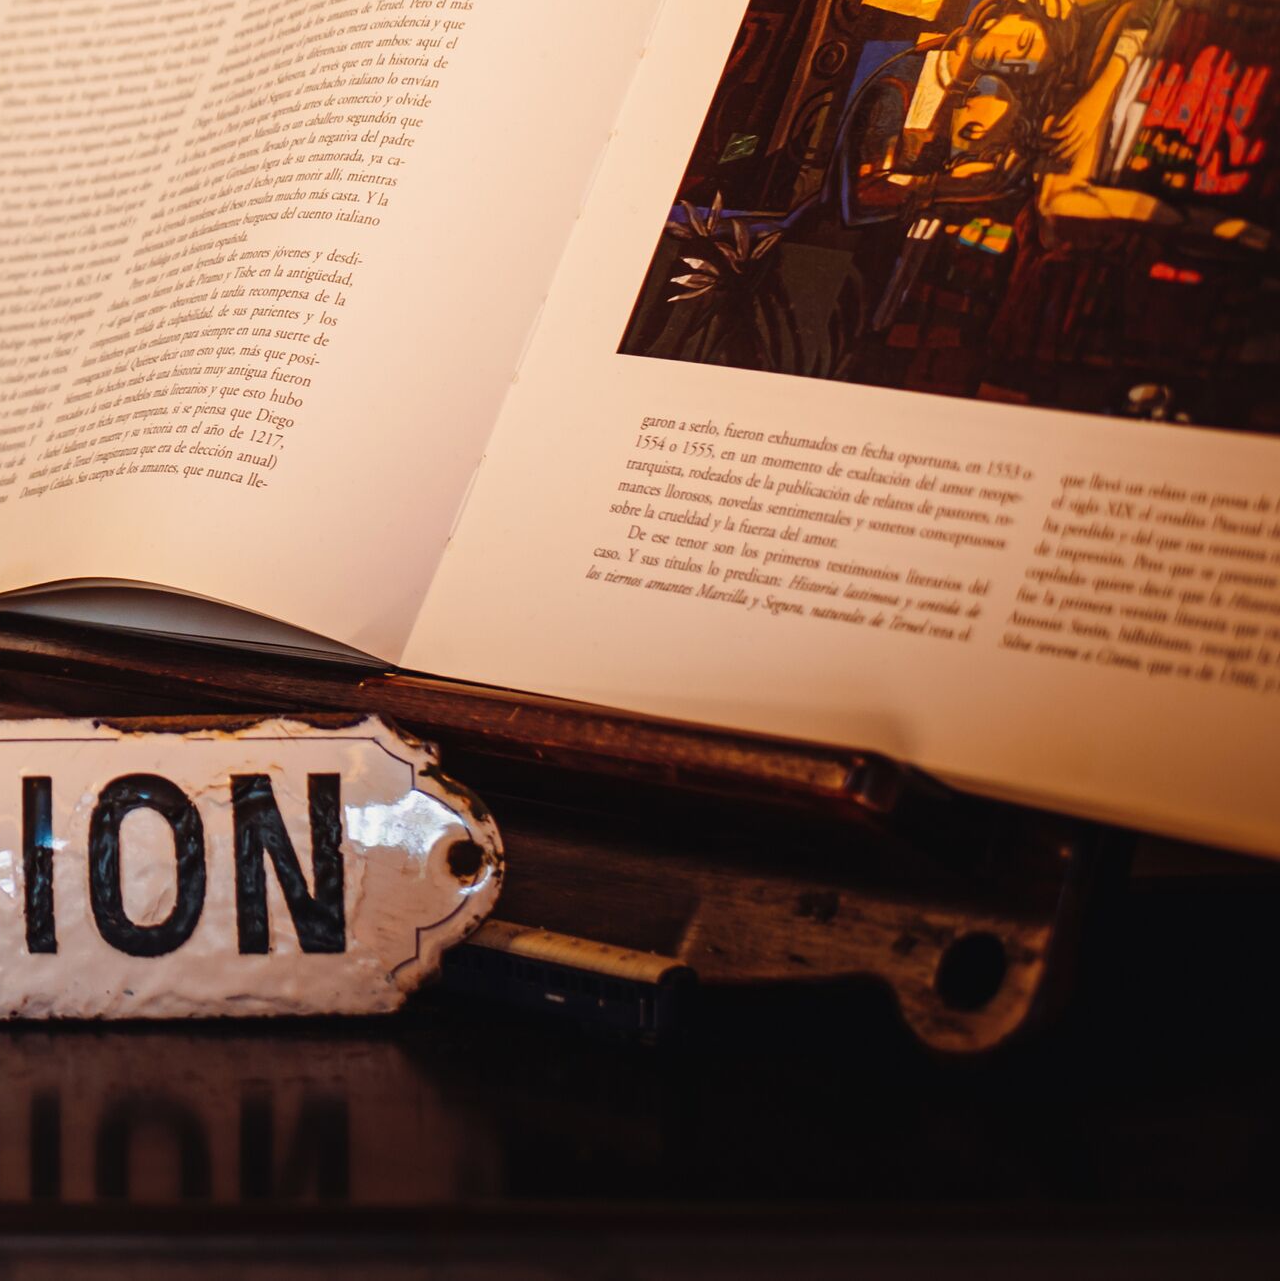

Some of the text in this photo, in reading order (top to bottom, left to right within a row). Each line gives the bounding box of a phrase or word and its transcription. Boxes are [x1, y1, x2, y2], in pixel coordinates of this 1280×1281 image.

[450, 0, 474, 10] más
[443, 20, 465, 33] que
[415, 36, 444, 51] aquí
[388, 53, 448, 69] historia de
[401, 75, 439, 88] envían
[395, 92, 431, 108] olvide
[346, 110, 423, 130] segundón que
[379, 132, 414, 148] padre
[347, 170, 397, 187] mientras
[331, 191, 389, 207] casta. Y la
[335, 208, 381, 226] italiano
[272, 246, 365, 265] jóvenes y desdi-
[274, 264, 352, 286] la antigüedad,
[248, 288, 346, 306] recompensa de la
[250, 304, 338, 327] parientes y los
[251, 328, 329, 347] una suerte de
[239, 344, 322, 366] más que posi-
[227, 363, 311, 387] antigua fueron
[219, 386, 303, 408] que esto hubo
[193, 401, 294, 430] piensa que Diego
[190, 420, 284, 450] el año de 1217,
[174, 440, 278, 470] de elección anual)
[641, 416, 676, 430] garon
[678, 421, 687, 431] a
[724, 422, 765, 442] fueron
[767, 430, 839, 453] exhumados
[841, 445, 858, 456] en
[860, 442, 895, 462] fecha
[965, 462, 982, 474] en
[987, 461, 1022, 480] 1553
[1022, 470, 1033, 481] o
[635, 434, 667, 451] 1554
[668, 443, 678, 453] o
[720, 450, 736, 461] en
[740, 453, 757, 464] un
[761, 456, 823, 474] momento
[826, 461, 844, 478] de
[846, 466, 912, 488] exaltación
[915, 474, 938, 492] del
[939, 483, 975, 497] amor
[183, 466, 269, 488] que nunca lle-
[688, 466, 743, 485] rodeados
[745, 472, 761, 488] de
[763, 474, 775, 491] la
[775, 479, 851, 502] publicación
[853, 489, 870, 506] de
[872, 493, 915, 512] relatos
[917, 499, 933, 515] de
[610, 500, 837, 549] sobre la crueldad y la fuerza del amor.
[618, 482, 662, 496] mances
[718, 495, 764, 512] novelas
[766, 503, 852, 526] sentimentales
[854, 518, 864, 532] y
[868, 520, 916, 537] sonetos
[919, 528, 1006, 550] conceptuosos
[627, 524, 991, 596] De ese tenor son los primeros testimonios literarios del
[628, 548, 638, 563] Y
[640, 555, 660, 567] sus
[664, 555, 703, 574] títulos
[707, 560, 720, 576] lo
